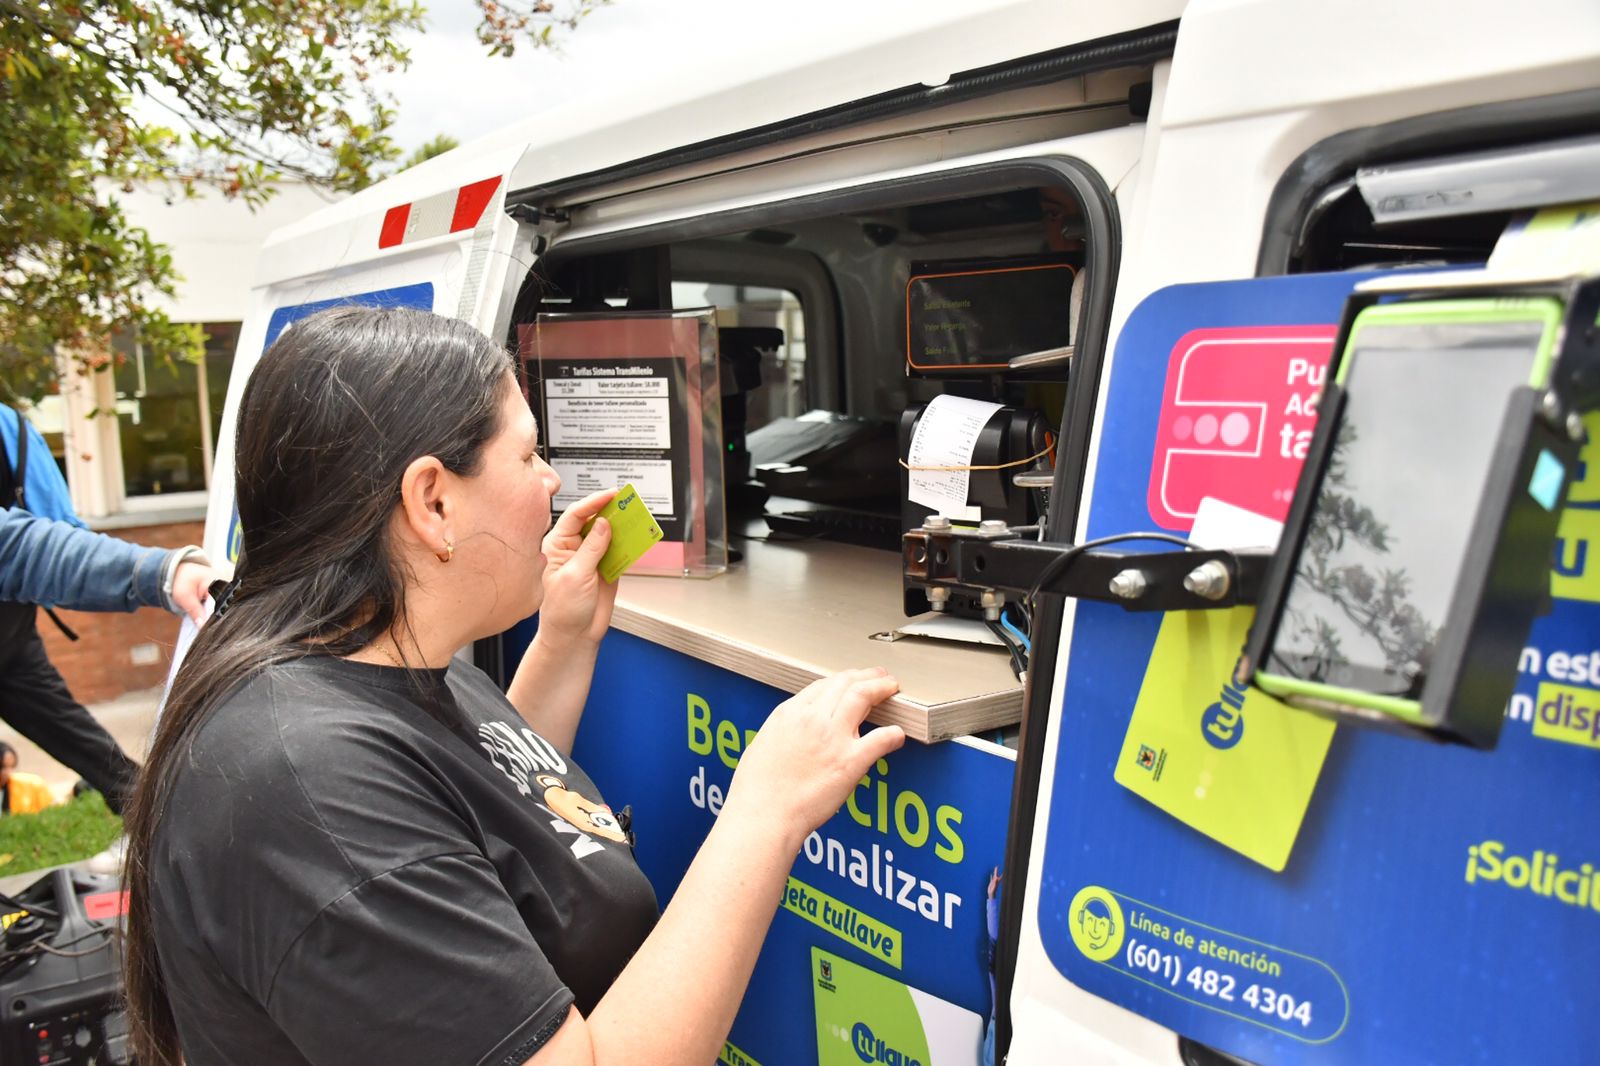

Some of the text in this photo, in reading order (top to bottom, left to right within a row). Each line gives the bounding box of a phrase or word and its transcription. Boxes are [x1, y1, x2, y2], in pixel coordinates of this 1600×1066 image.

[1503, 693, 1534, 722] n
[687, 693, 964, 864] Becios
[689, 766, 724, 816] de
[797, 830, 962, 929] onalizar
[823, 900, 894, 958] tullave
[1130, 911, 1281, 977] Línea de atención
[1126, 939, 1312, 1027] (601) 482 4304
